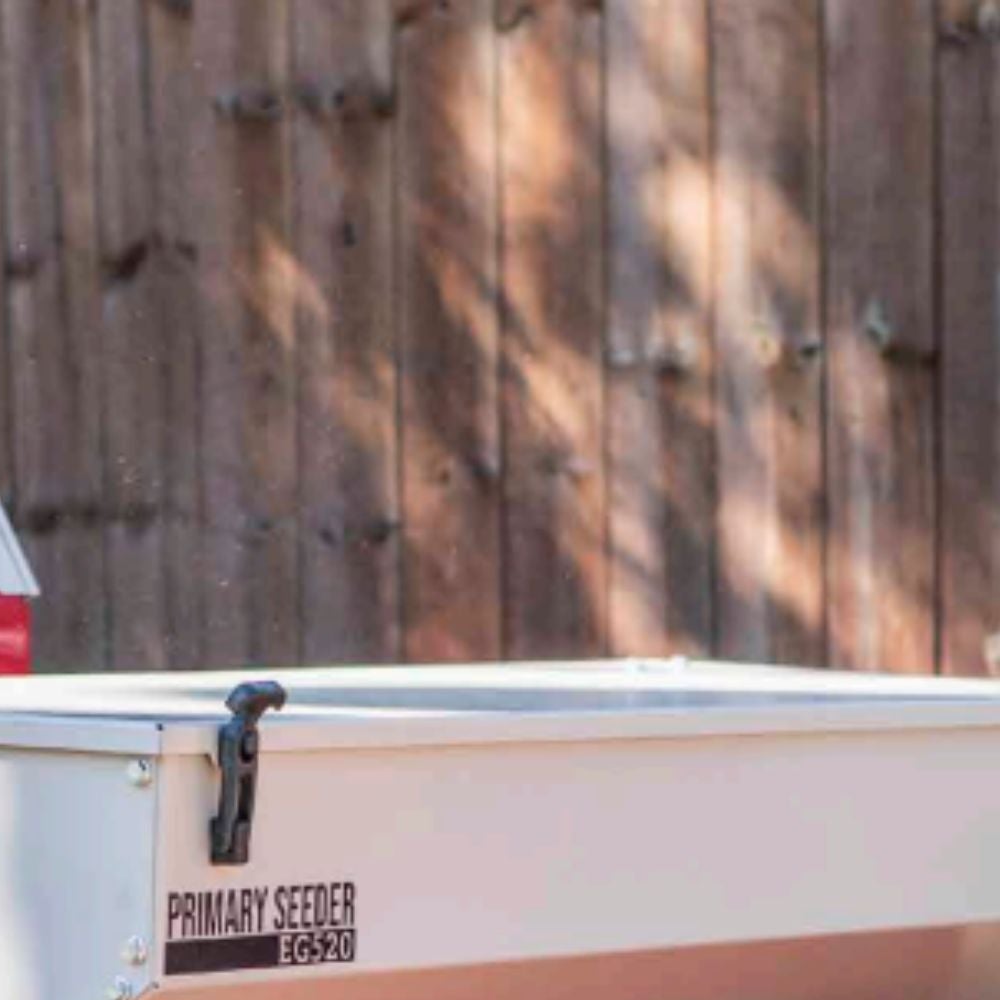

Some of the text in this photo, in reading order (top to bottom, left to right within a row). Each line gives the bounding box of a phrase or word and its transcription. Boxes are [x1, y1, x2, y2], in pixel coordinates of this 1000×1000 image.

[168, 881, 355, 939] PRIMARY SEEDER
[279, 931, 352, 964] EG520
